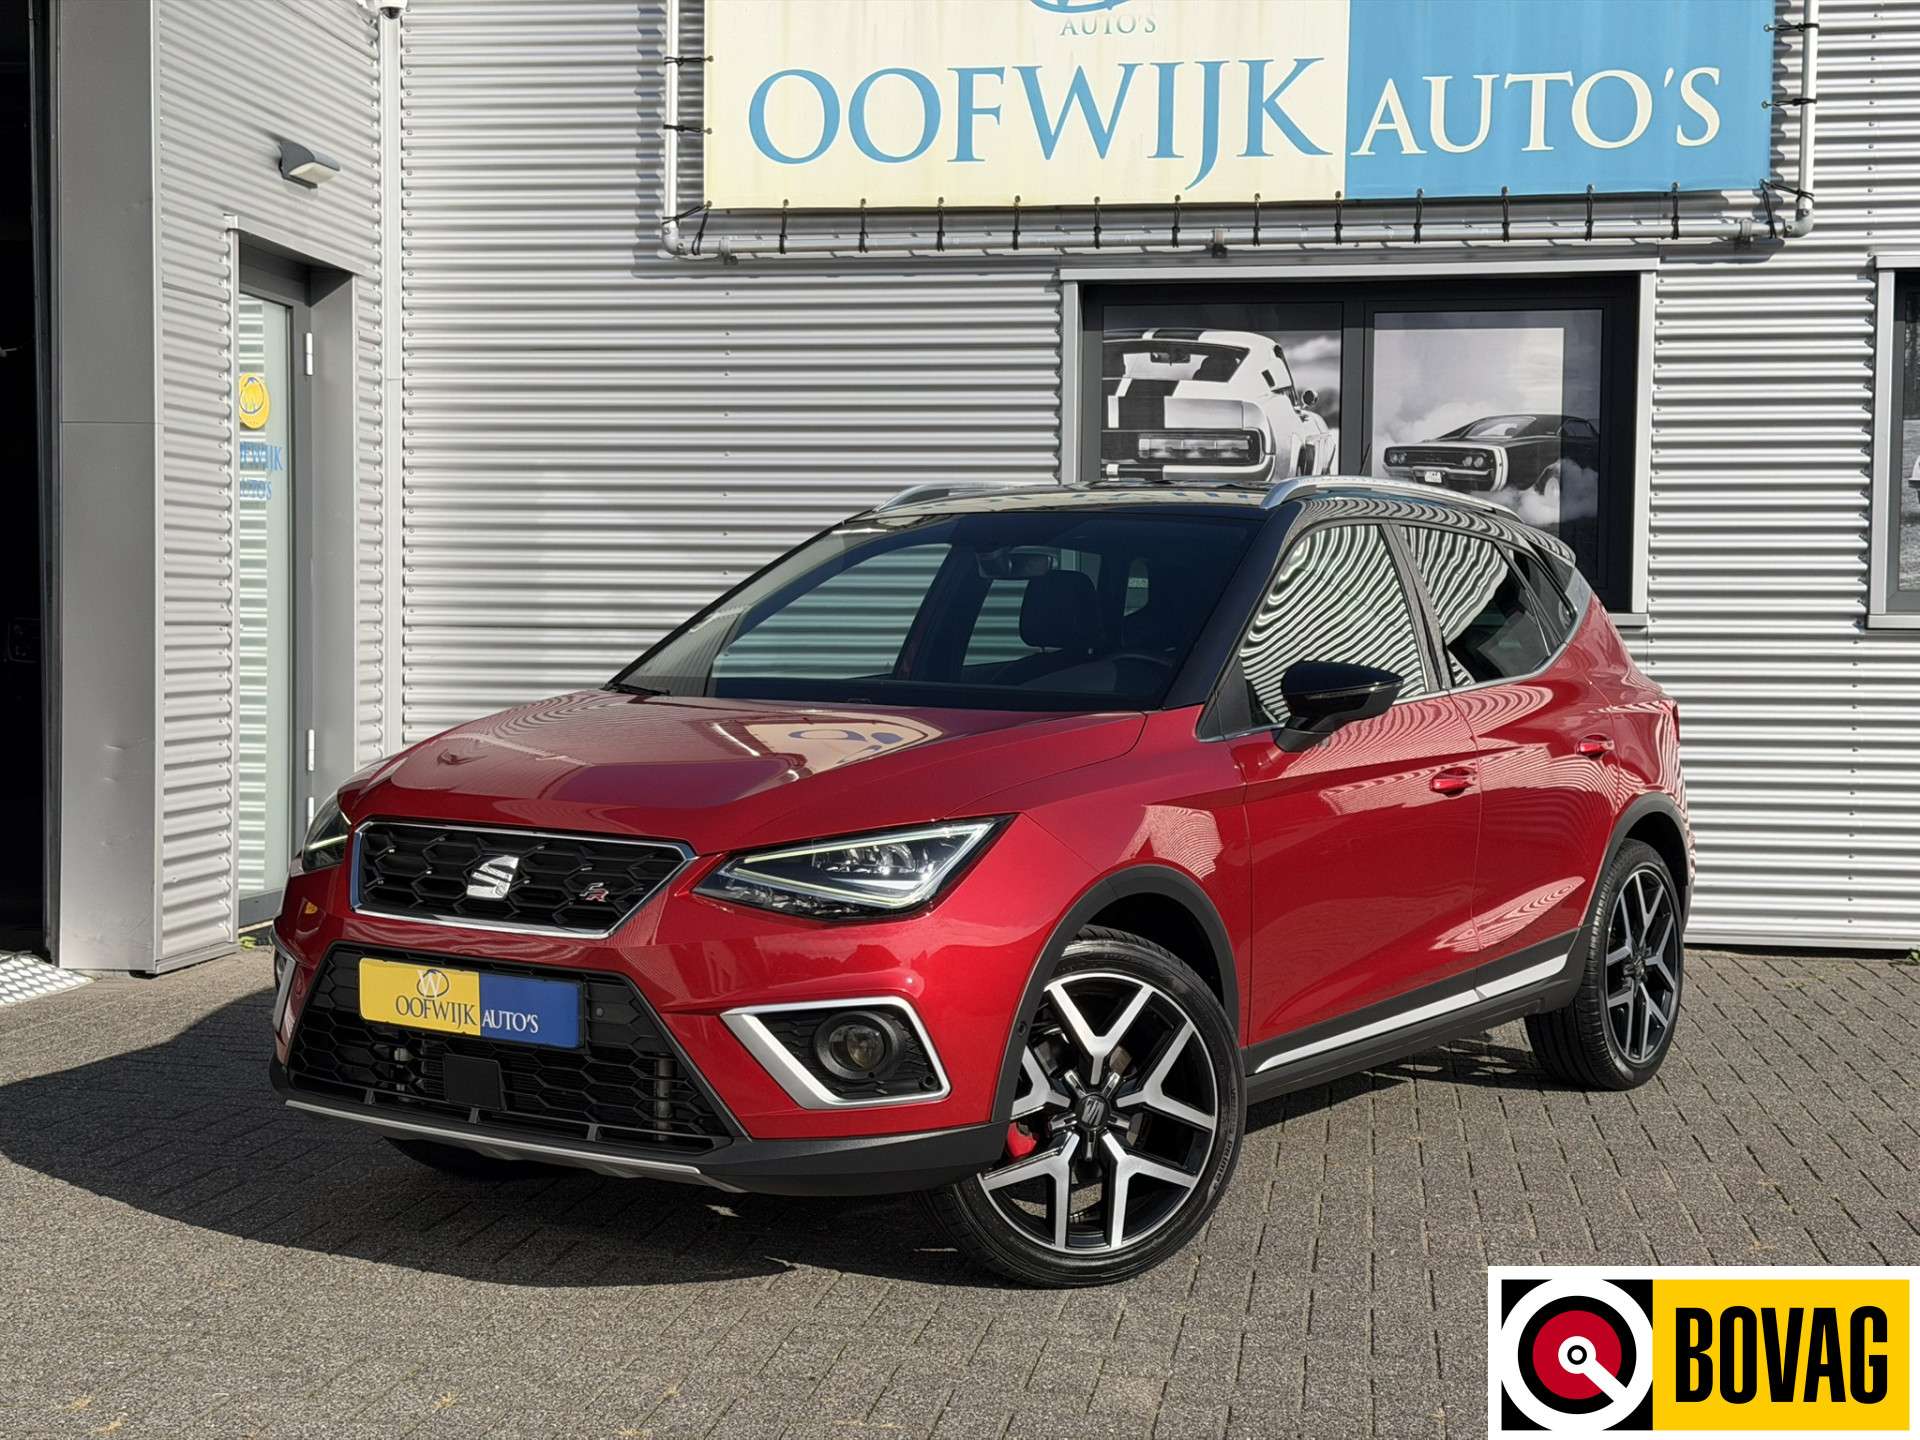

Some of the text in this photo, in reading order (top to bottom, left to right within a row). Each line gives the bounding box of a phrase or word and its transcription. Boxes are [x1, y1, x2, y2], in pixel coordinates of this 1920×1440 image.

[1060, 15, 1156, 36] AUTO'S
[748, 58, 1720, 190] OOFWIJK AUTO'S
[396, 995, 538, 1034] OOFWIJK AUTO'S
